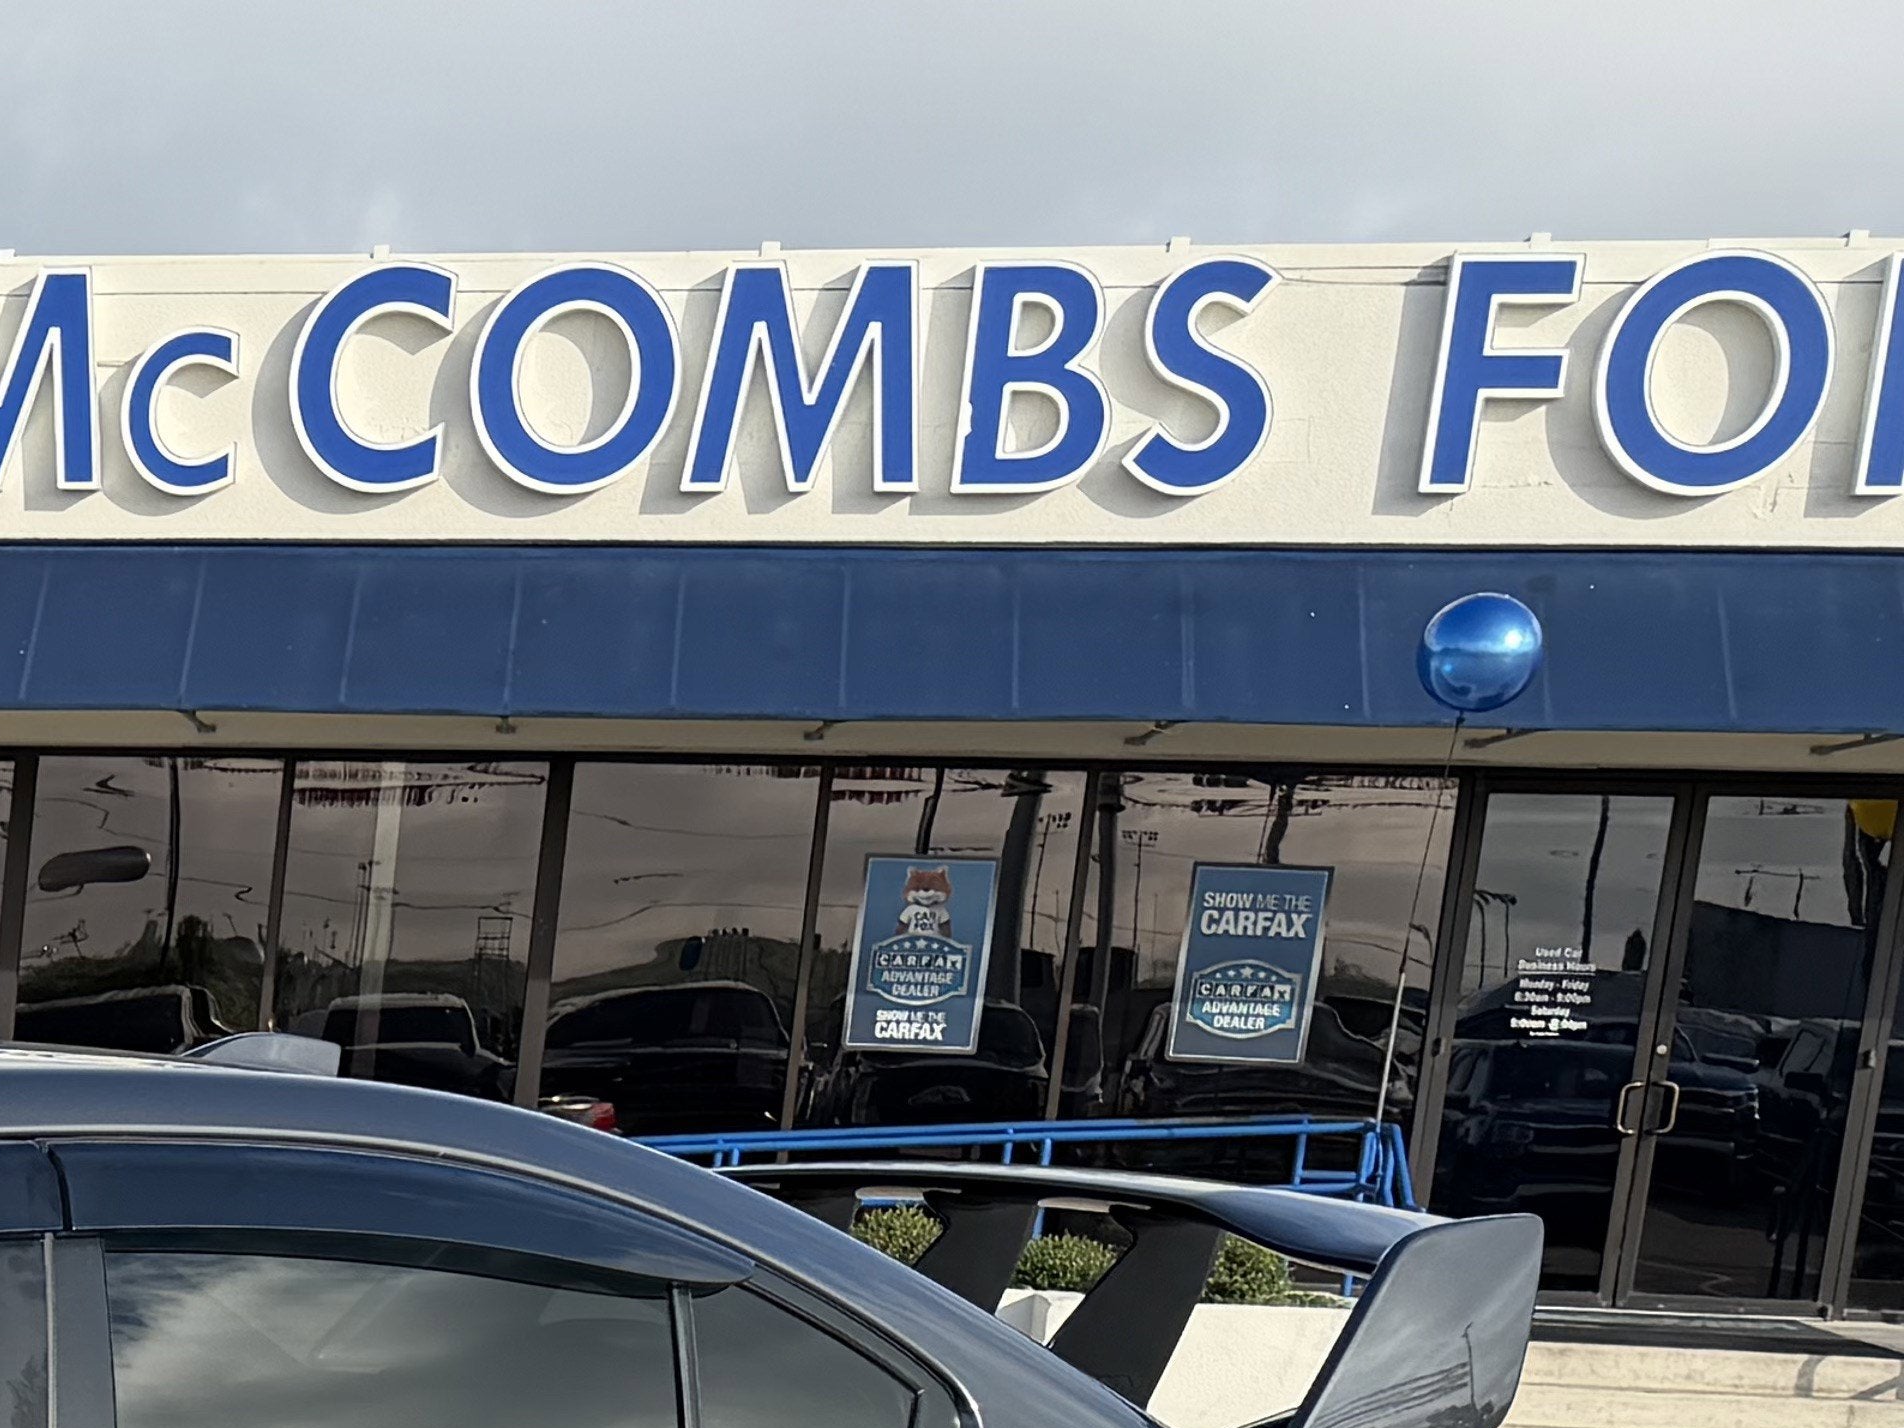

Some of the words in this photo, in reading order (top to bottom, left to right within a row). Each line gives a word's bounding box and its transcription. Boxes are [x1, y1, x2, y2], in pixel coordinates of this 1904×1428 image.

[1418, 246, 1904, 498] FO
[1203, 891, 1255, 909] SHOW
[1256, 893, 1280, 911] ME
[1283, 894, 1313, 912] THE
[1200, 909, 1313, 938] CARFAX
[878, 953, 961, 971] CARFAX
[881, 969, 954, 985] ADVANTAGE
[892, 984, 940, 997] DEALER
[1199, 984, 1290, 1000] CARFAX
[876, 1009, 909, 1022] SHOW
[1202, 1000, 1281, 1017] ADVANTAGE
[874, 1021, 947, 1041] CARFAX
[1213, 1015, 1265, 1030] DEALER
